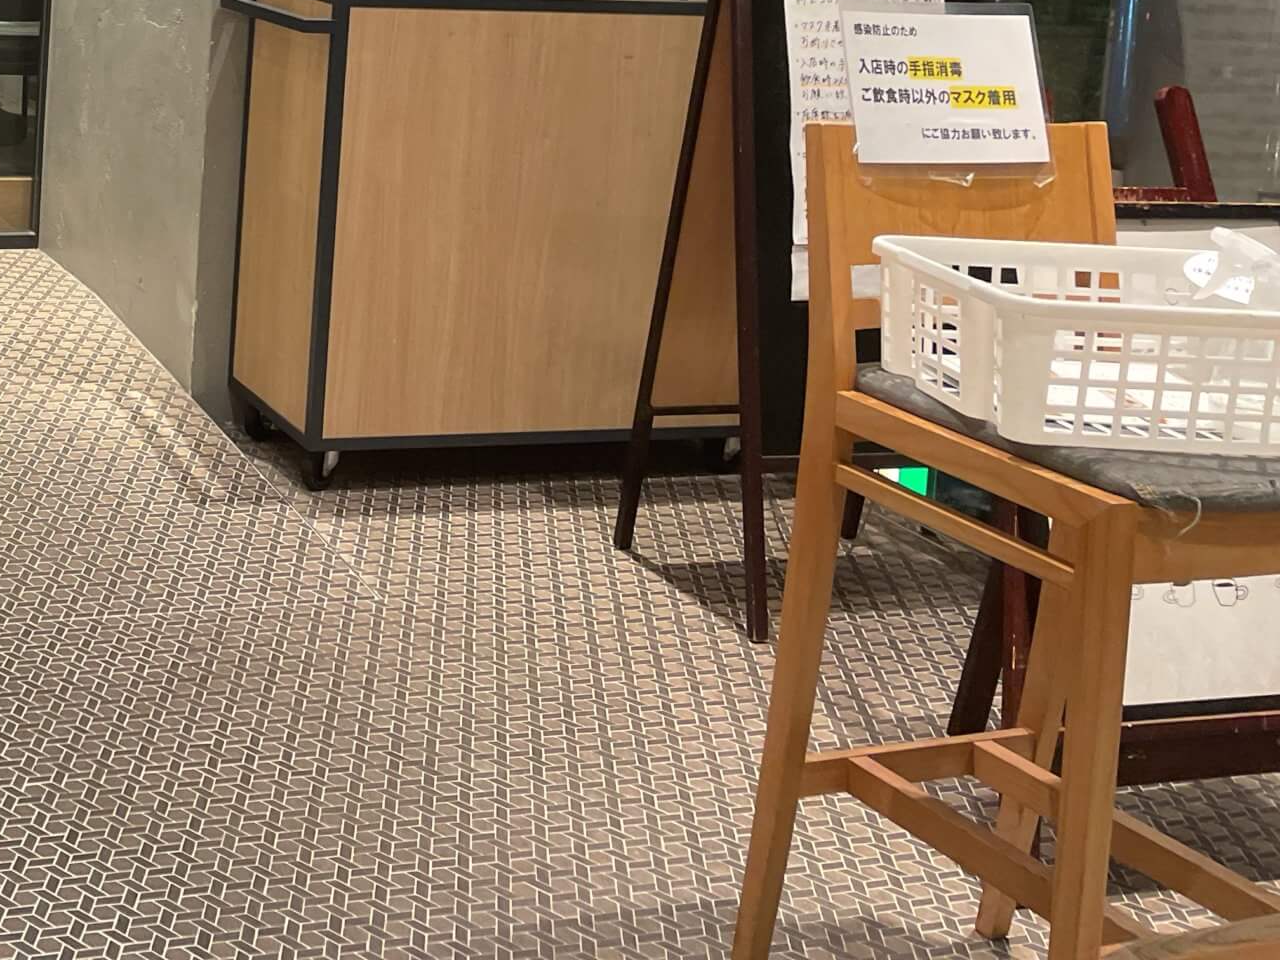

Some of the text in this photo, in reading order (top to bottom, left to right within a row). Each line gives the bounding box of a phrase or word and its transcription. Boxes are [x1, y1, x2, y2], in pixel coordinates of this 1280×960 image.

[853, 23, 918, 37] 感染防止のため
[858, 58, 963, 78] 入店時の手指消毒
[861, 87, 1017, 106] ご飲食時以外のマスク着用
[921, 127, 1037, 141] にご協力お願い致します。
